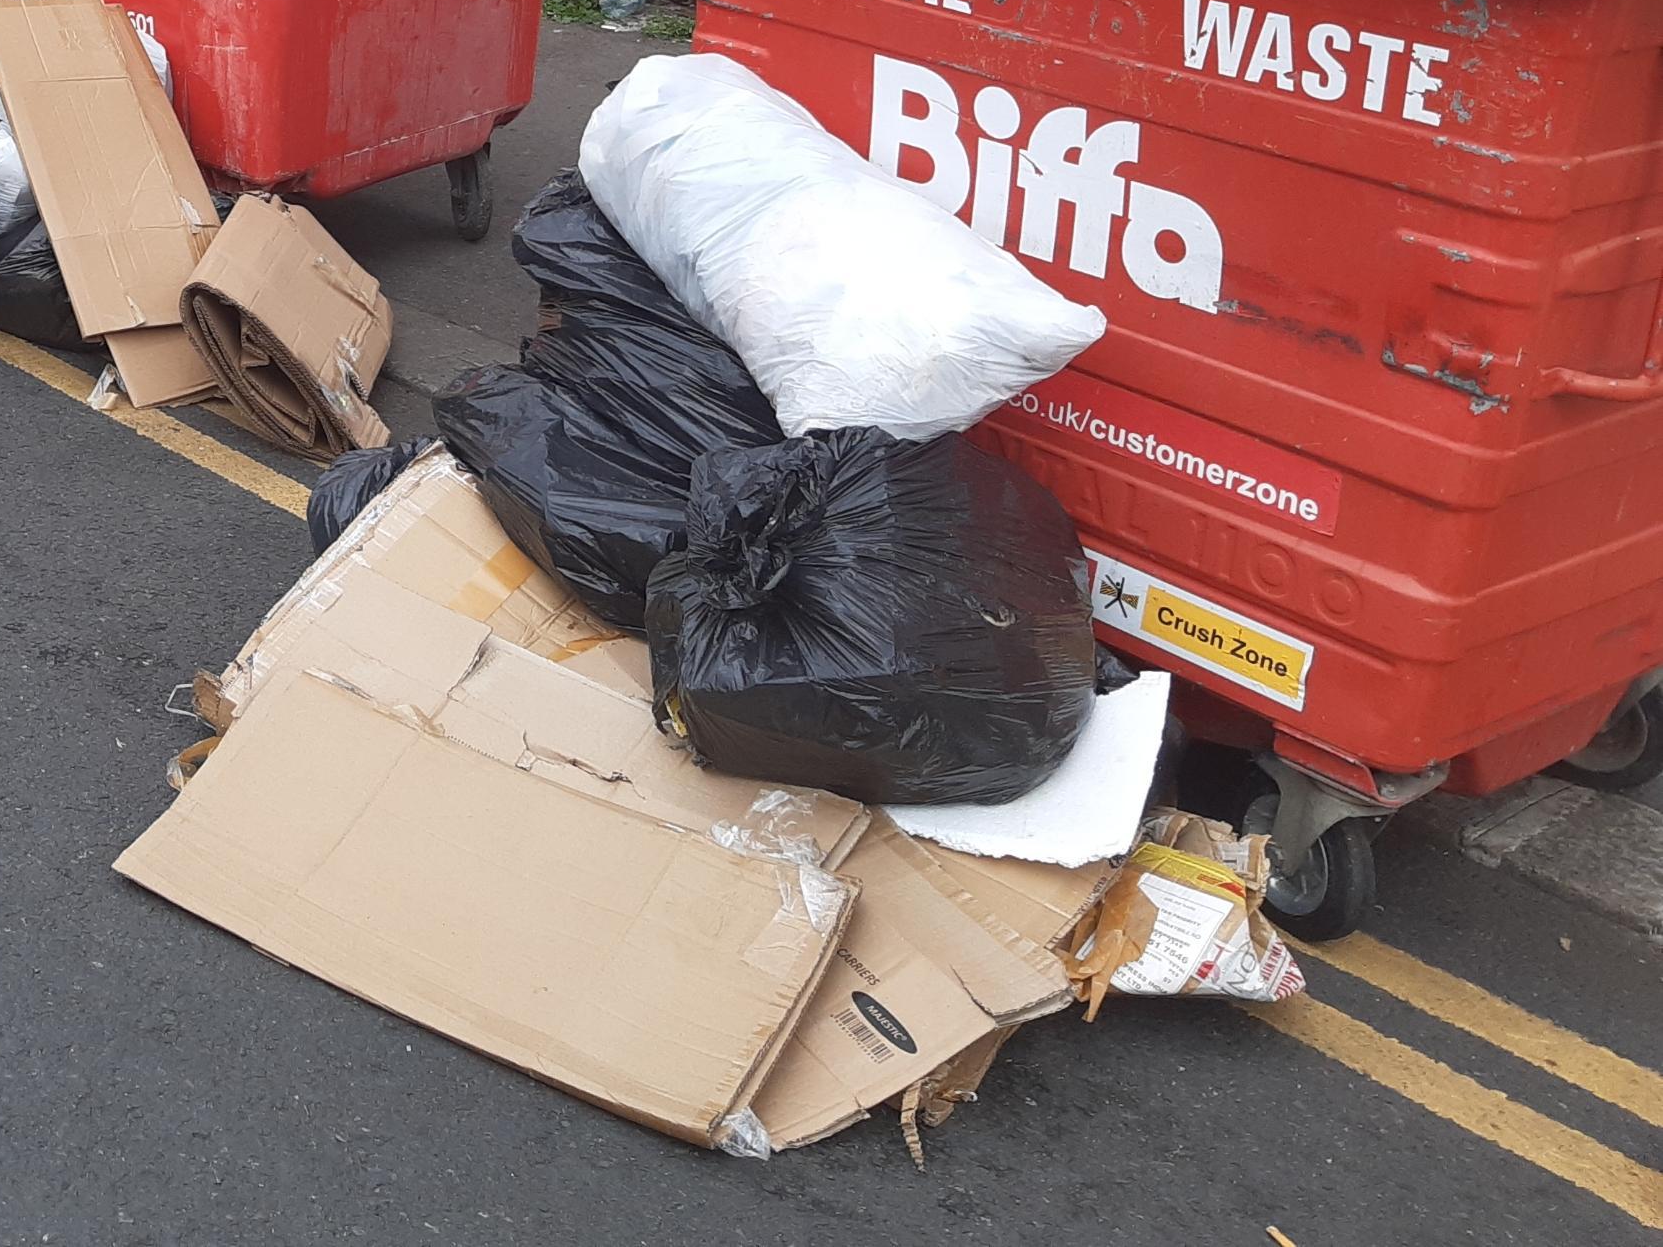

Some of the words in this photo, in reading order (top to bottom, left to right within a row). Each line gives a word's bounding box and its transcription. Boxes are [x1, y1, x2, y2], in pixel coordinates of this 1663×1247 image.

[868, 53, 1224, 314] Biffa
[1007, 385, 1320, 522] co.uk/customerzone
[1156, 605, 1224, 651] Crush
[1229, 636, 1289, 678] Zone
[836, 947, 881, 988] CARRIERS
